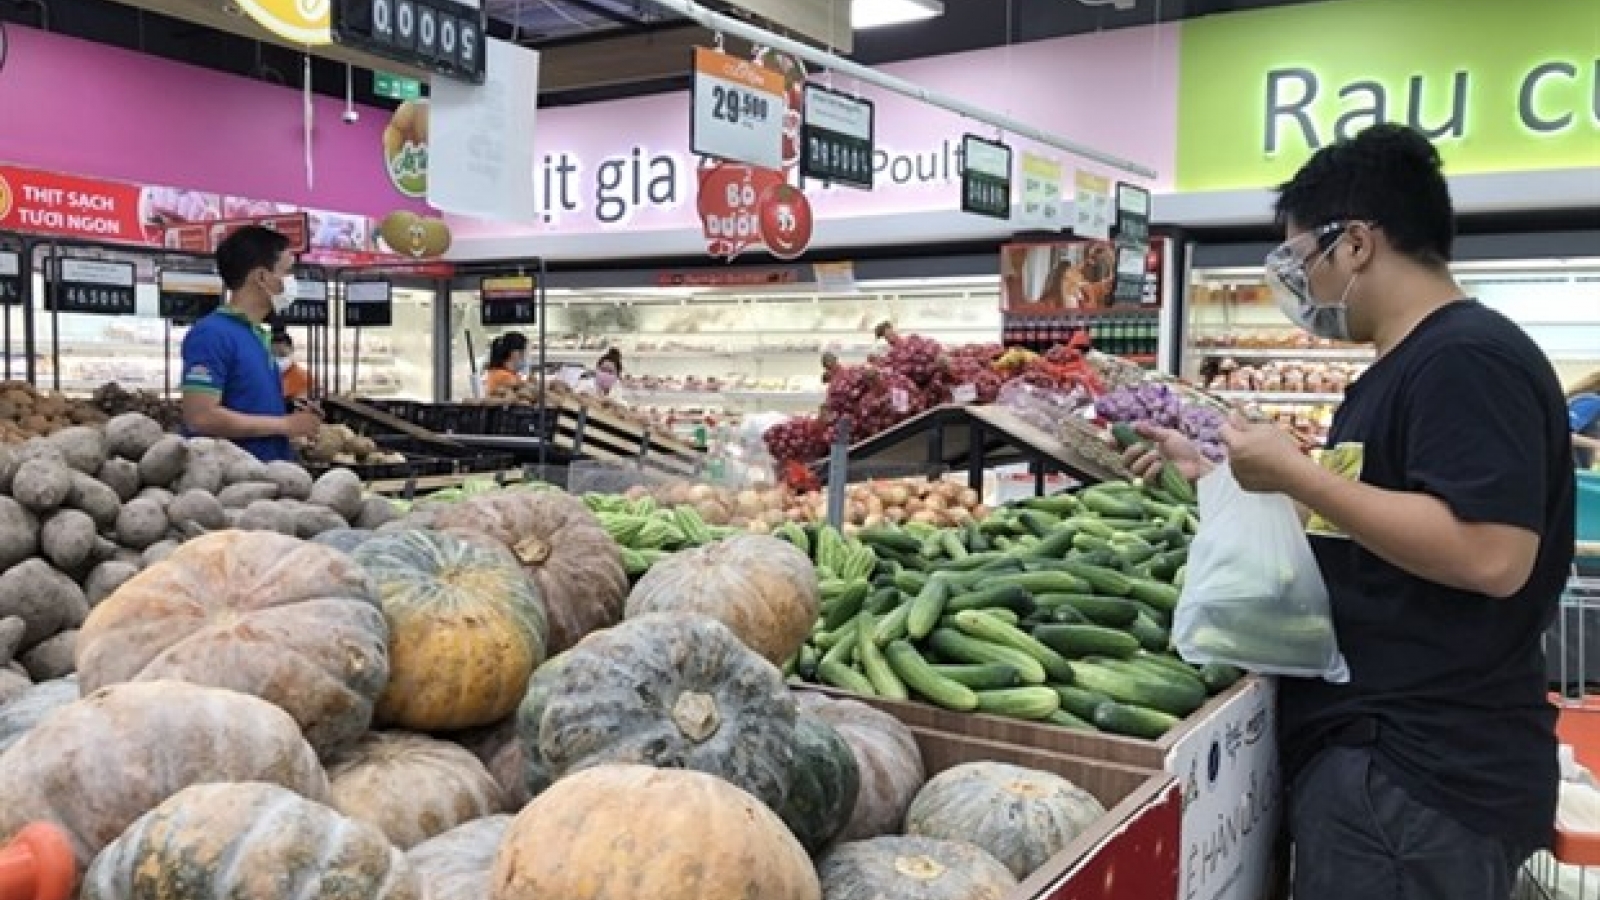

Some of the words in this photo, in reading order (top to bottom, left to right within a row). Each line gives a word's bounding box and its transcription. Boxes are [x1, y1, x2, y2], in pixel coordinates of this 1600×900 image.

[1264, 67, 1468, 154] Rau
[22, 184, 64, 207] THỊT
[66, 191, 115, 212] SẠCH
[596, 147, 677, 223] gia
[66, 214, 120, 234] NGON
